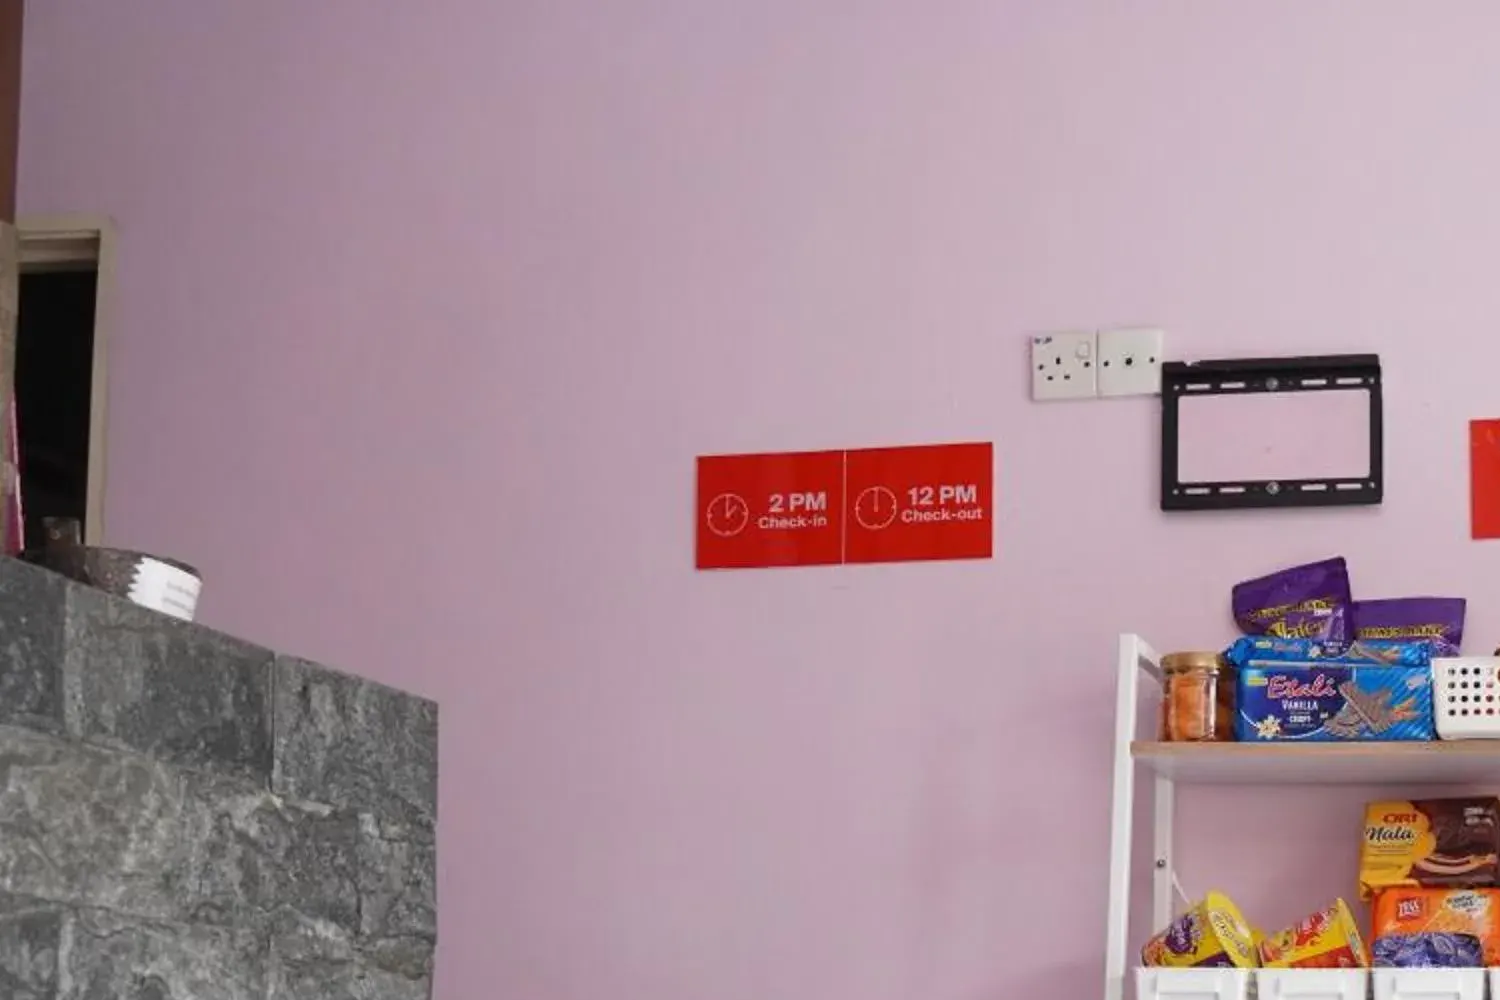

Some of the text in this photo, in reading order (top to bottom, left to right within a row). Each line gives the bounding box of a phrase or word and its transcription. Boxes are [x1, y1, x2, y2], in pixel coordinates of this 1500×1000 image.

[768, 492, 827, 513] 2 PM
[907, 484, 978, 506] 12 PM
[758, 515, 828, 530] Check-in
[901, 508, 983, 523] Check-out
